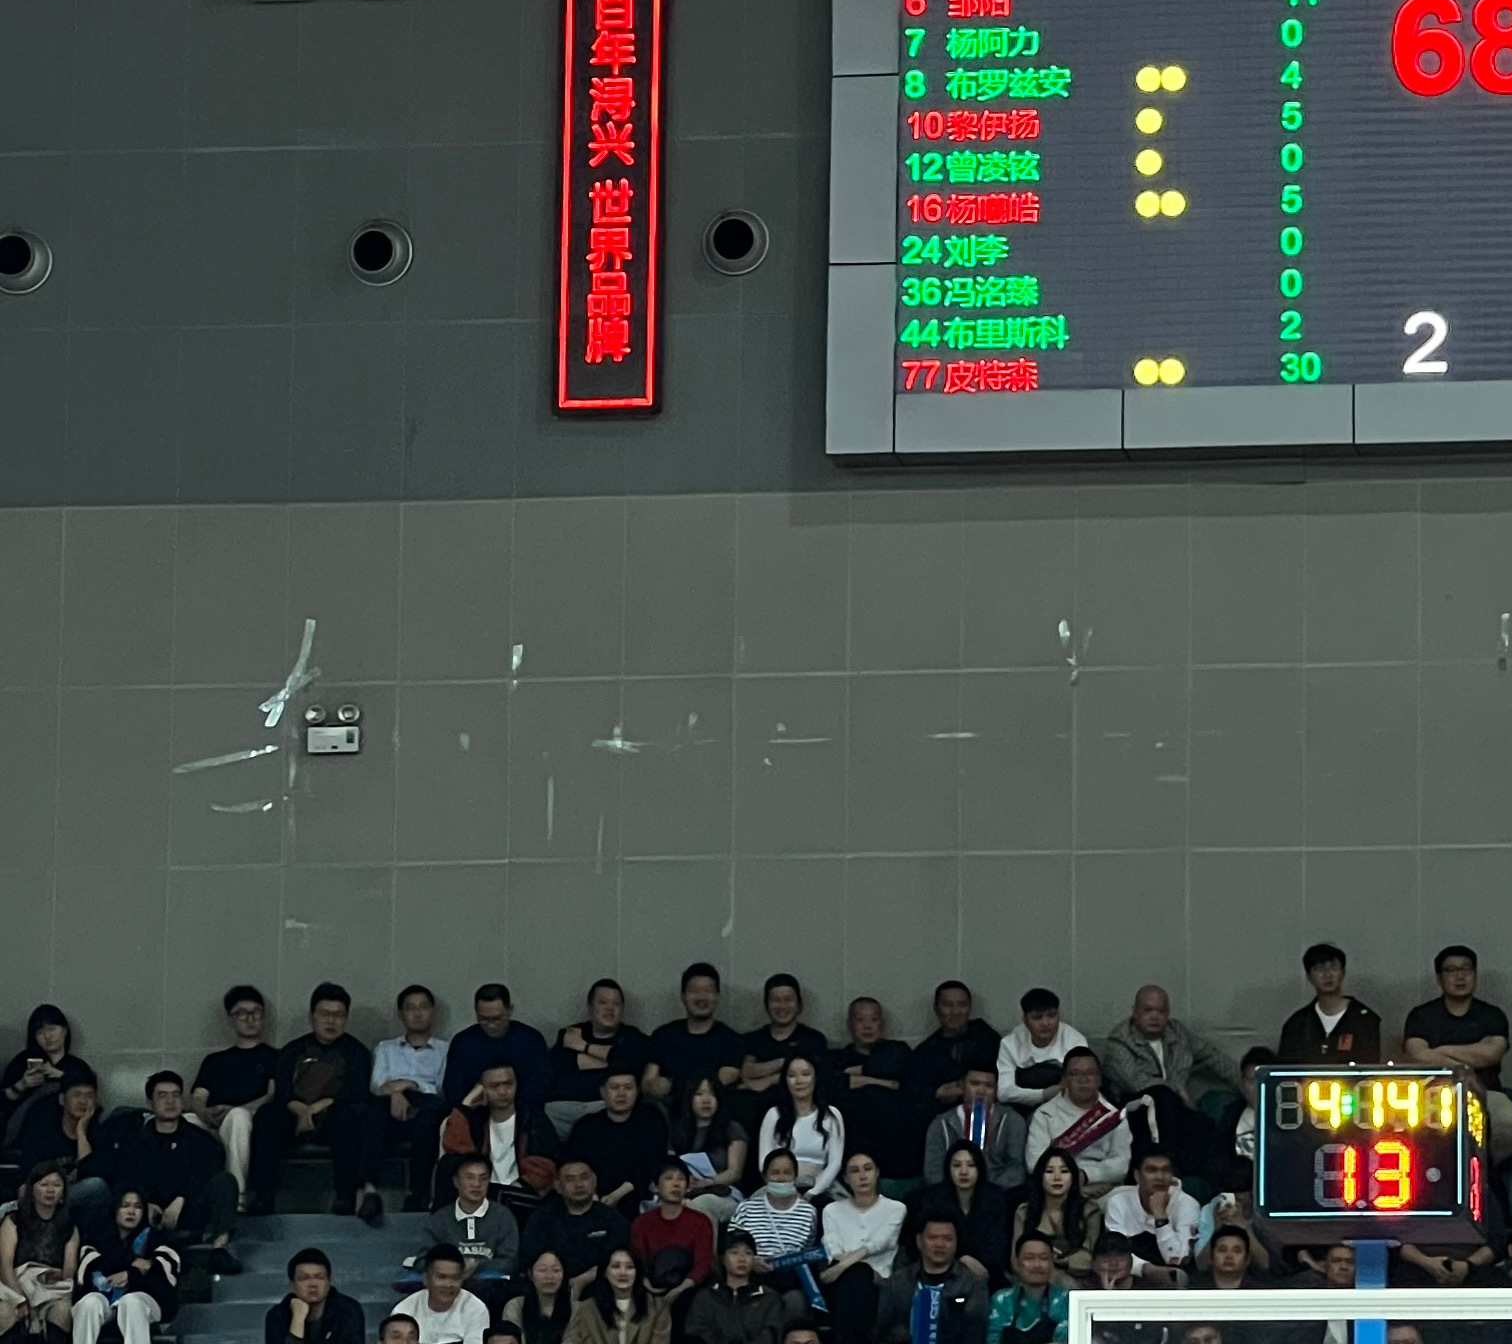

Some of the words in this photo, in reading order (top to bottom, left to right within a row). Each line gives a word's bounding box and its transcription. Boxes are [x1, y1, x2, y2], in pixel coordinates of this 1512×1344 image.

[904, 27, 927, 58] 7
[1280, 17, 1305, 49] 0
[904, 69, 928, 100] 8
[1280, 60, 1304, 90] 4
[1281, 102, 1304, 131] 5
[1280, 142, 1305, 173] 0
[1280, 183, 1304, 215] 5
[1280, 226, 1304, 258] 0
[584, 177, 635, 364] 世界品牌
[1280, 268, 1304, 298] 0
[1280, 310, 1304, 341] 2
[1403, 312, 1447, 373] 2
[1280, 351, 1324, 383] 30
[1343, 1140, 1413, 1209] 13
